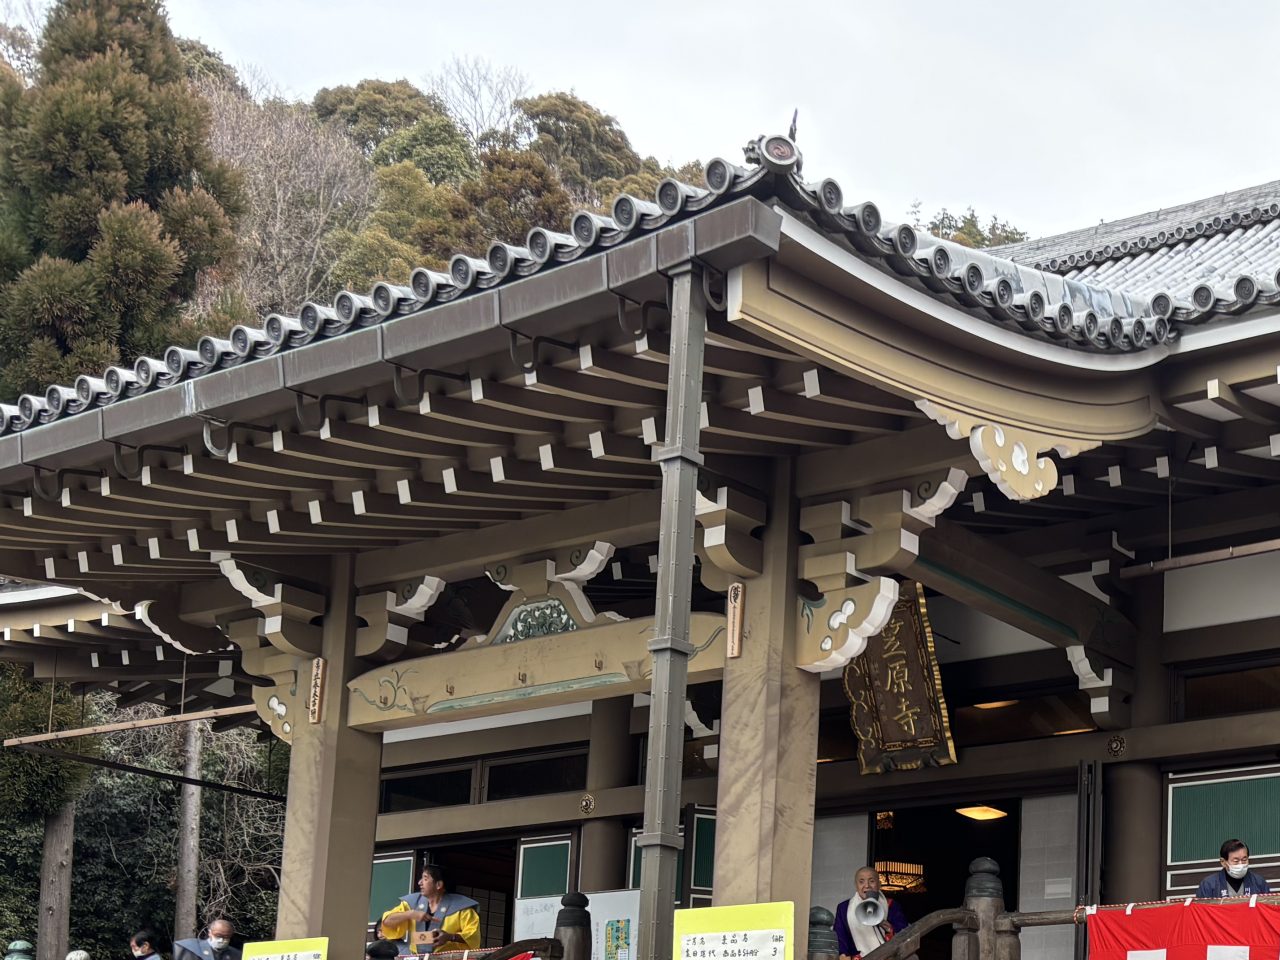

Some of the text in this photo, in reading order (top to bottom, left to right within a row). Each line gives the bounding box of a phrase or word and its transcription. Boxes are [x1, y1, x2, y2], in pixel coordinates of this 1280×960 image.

[881, 617, 921, 737] 笠原寺
[771, 947, 778, 957] 3
